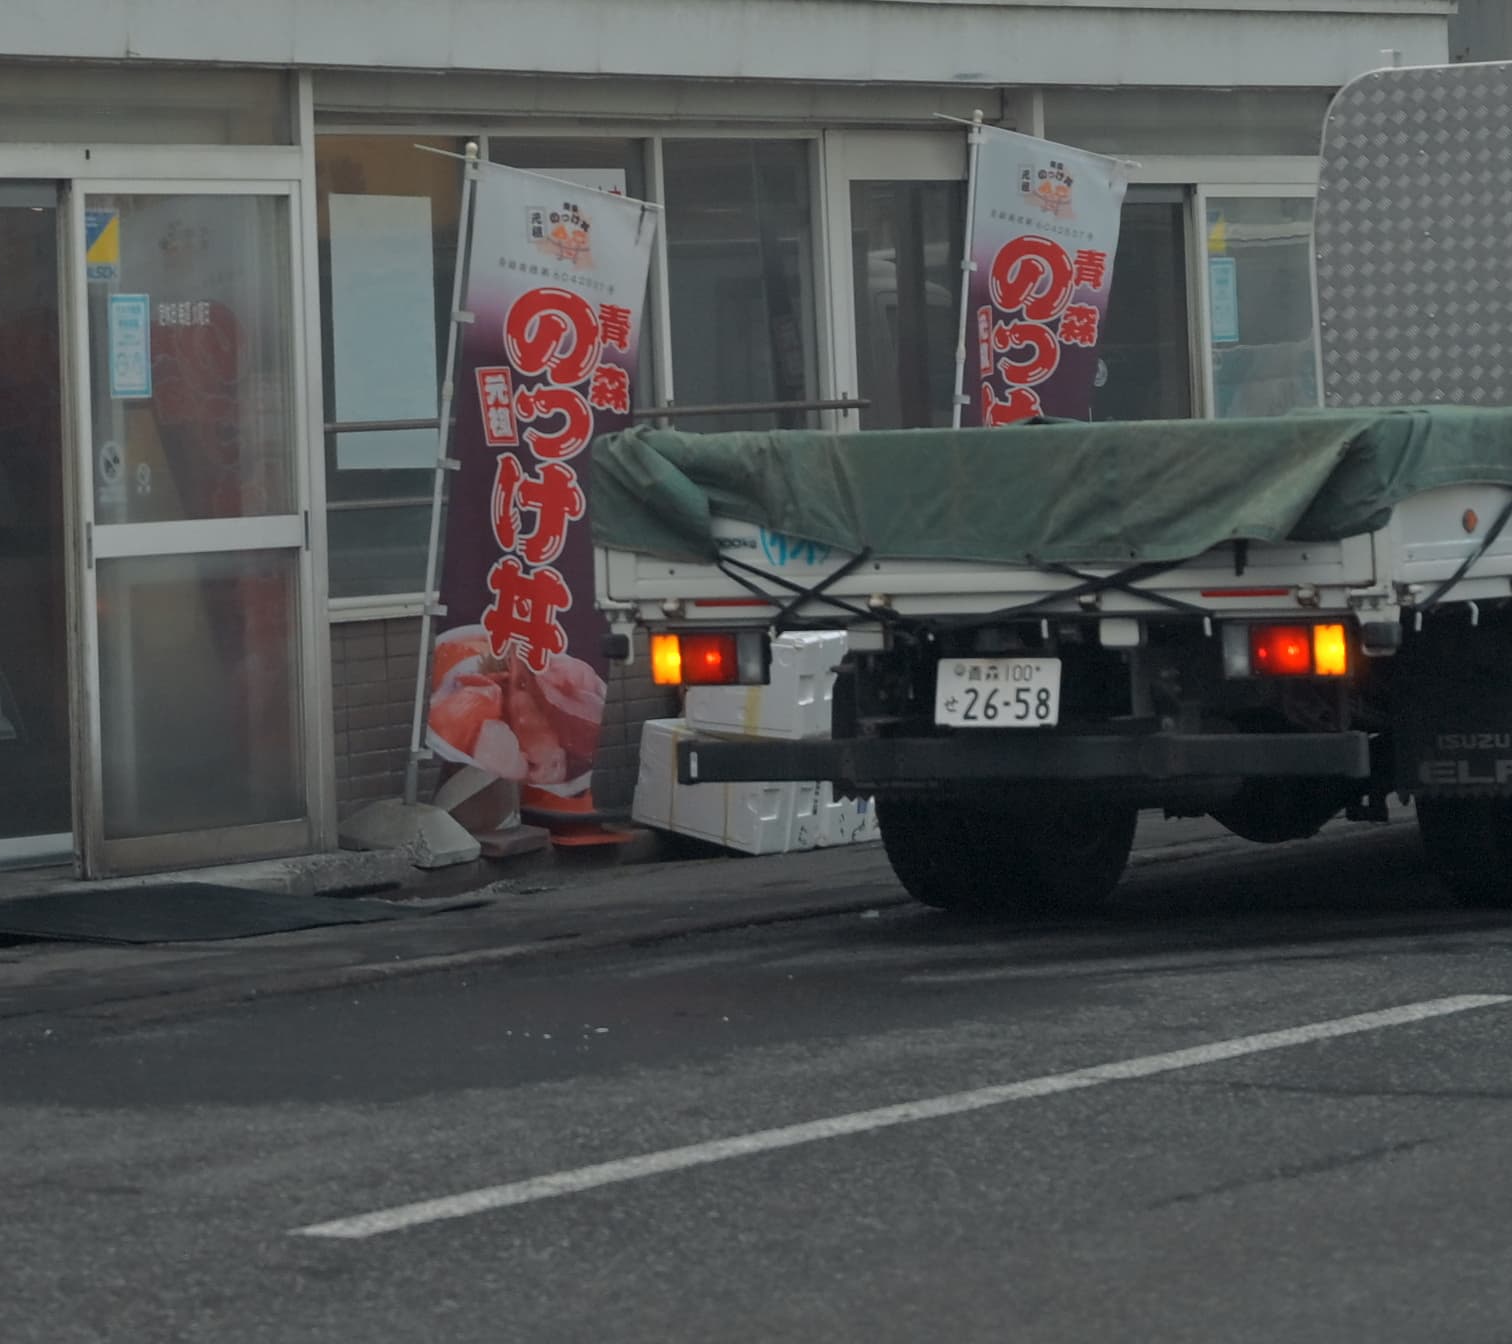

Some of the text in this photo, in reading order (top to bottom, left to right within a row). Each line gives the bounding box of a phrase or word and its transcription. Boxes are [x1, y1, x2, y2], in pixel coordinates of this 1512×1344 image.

[481, 287, 604, 673] のっけ丼
[963, 688, 1051, 720] 26-58
[1437, 732, 1511, 750] ISUZU
